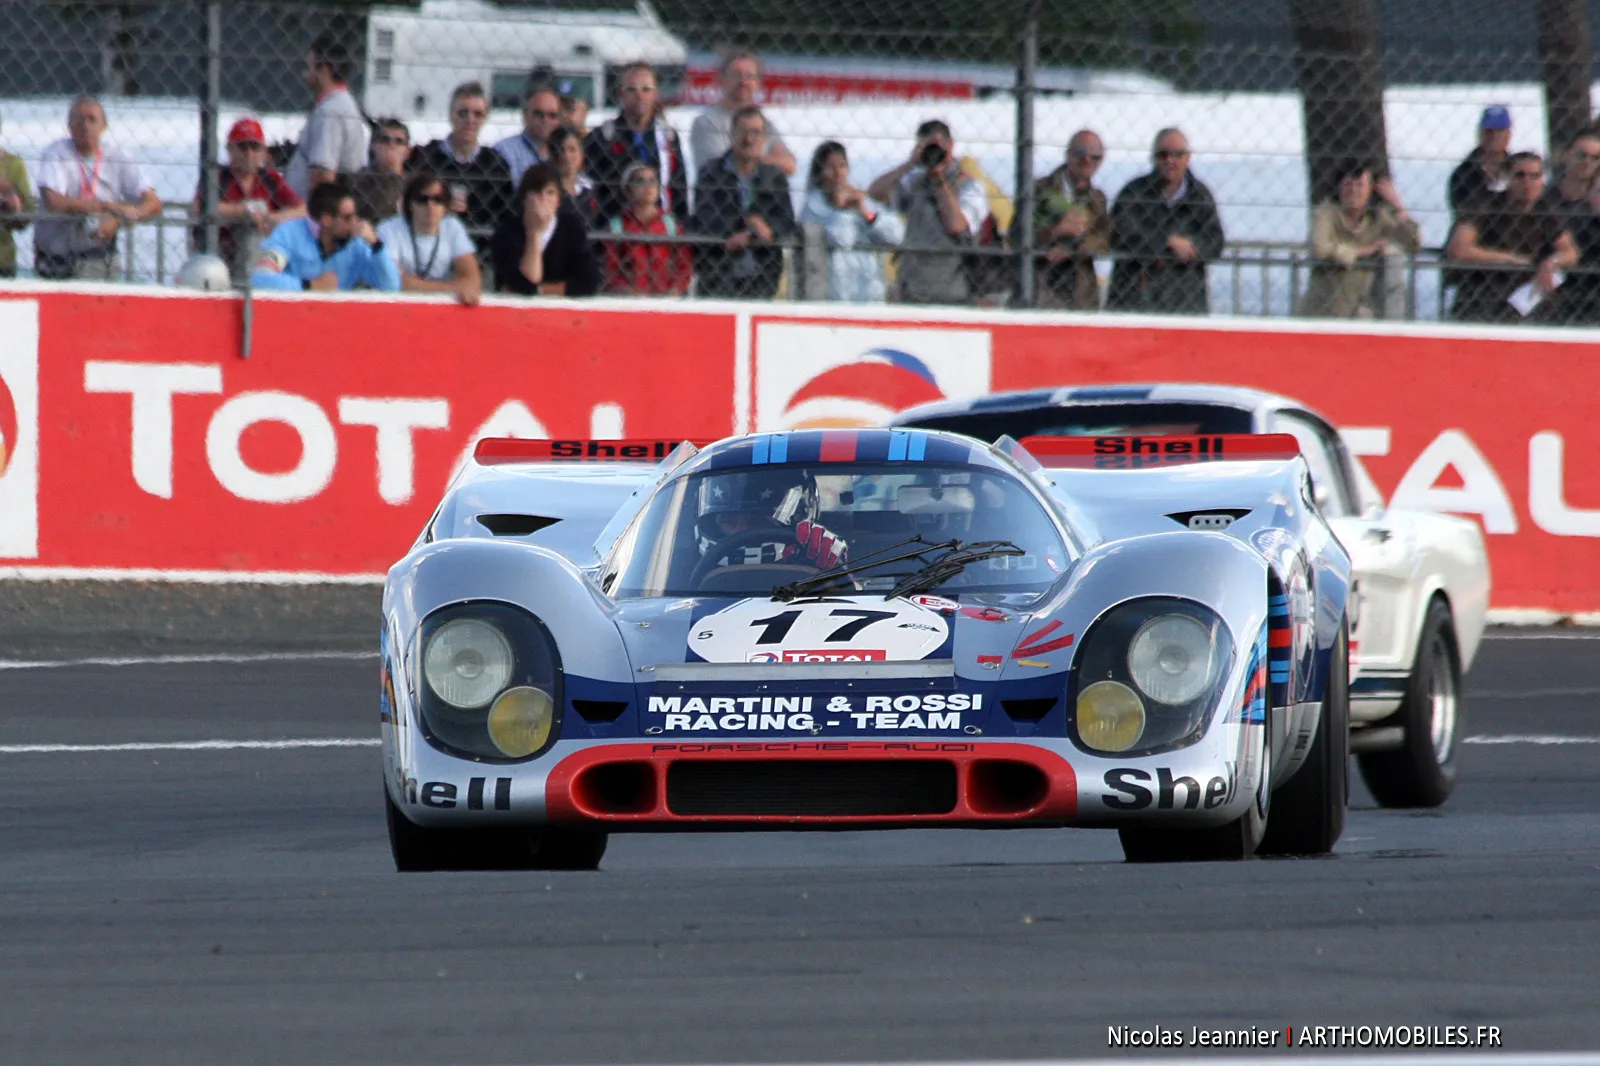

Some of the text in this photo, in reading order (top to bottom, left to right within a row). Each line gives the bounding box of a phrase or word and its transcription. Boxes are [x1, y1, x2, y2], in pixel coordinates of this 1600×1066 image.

[1094, 437, 1223, 454] Shell
[697, 630, 714, 640] 5
[750, 609, 898, 645] 17
[648, 694, 983, 713] MARTINI & ROSSI
[664, 713, 814, 731] RACING
[850, 712, 961, 729] TEAM
